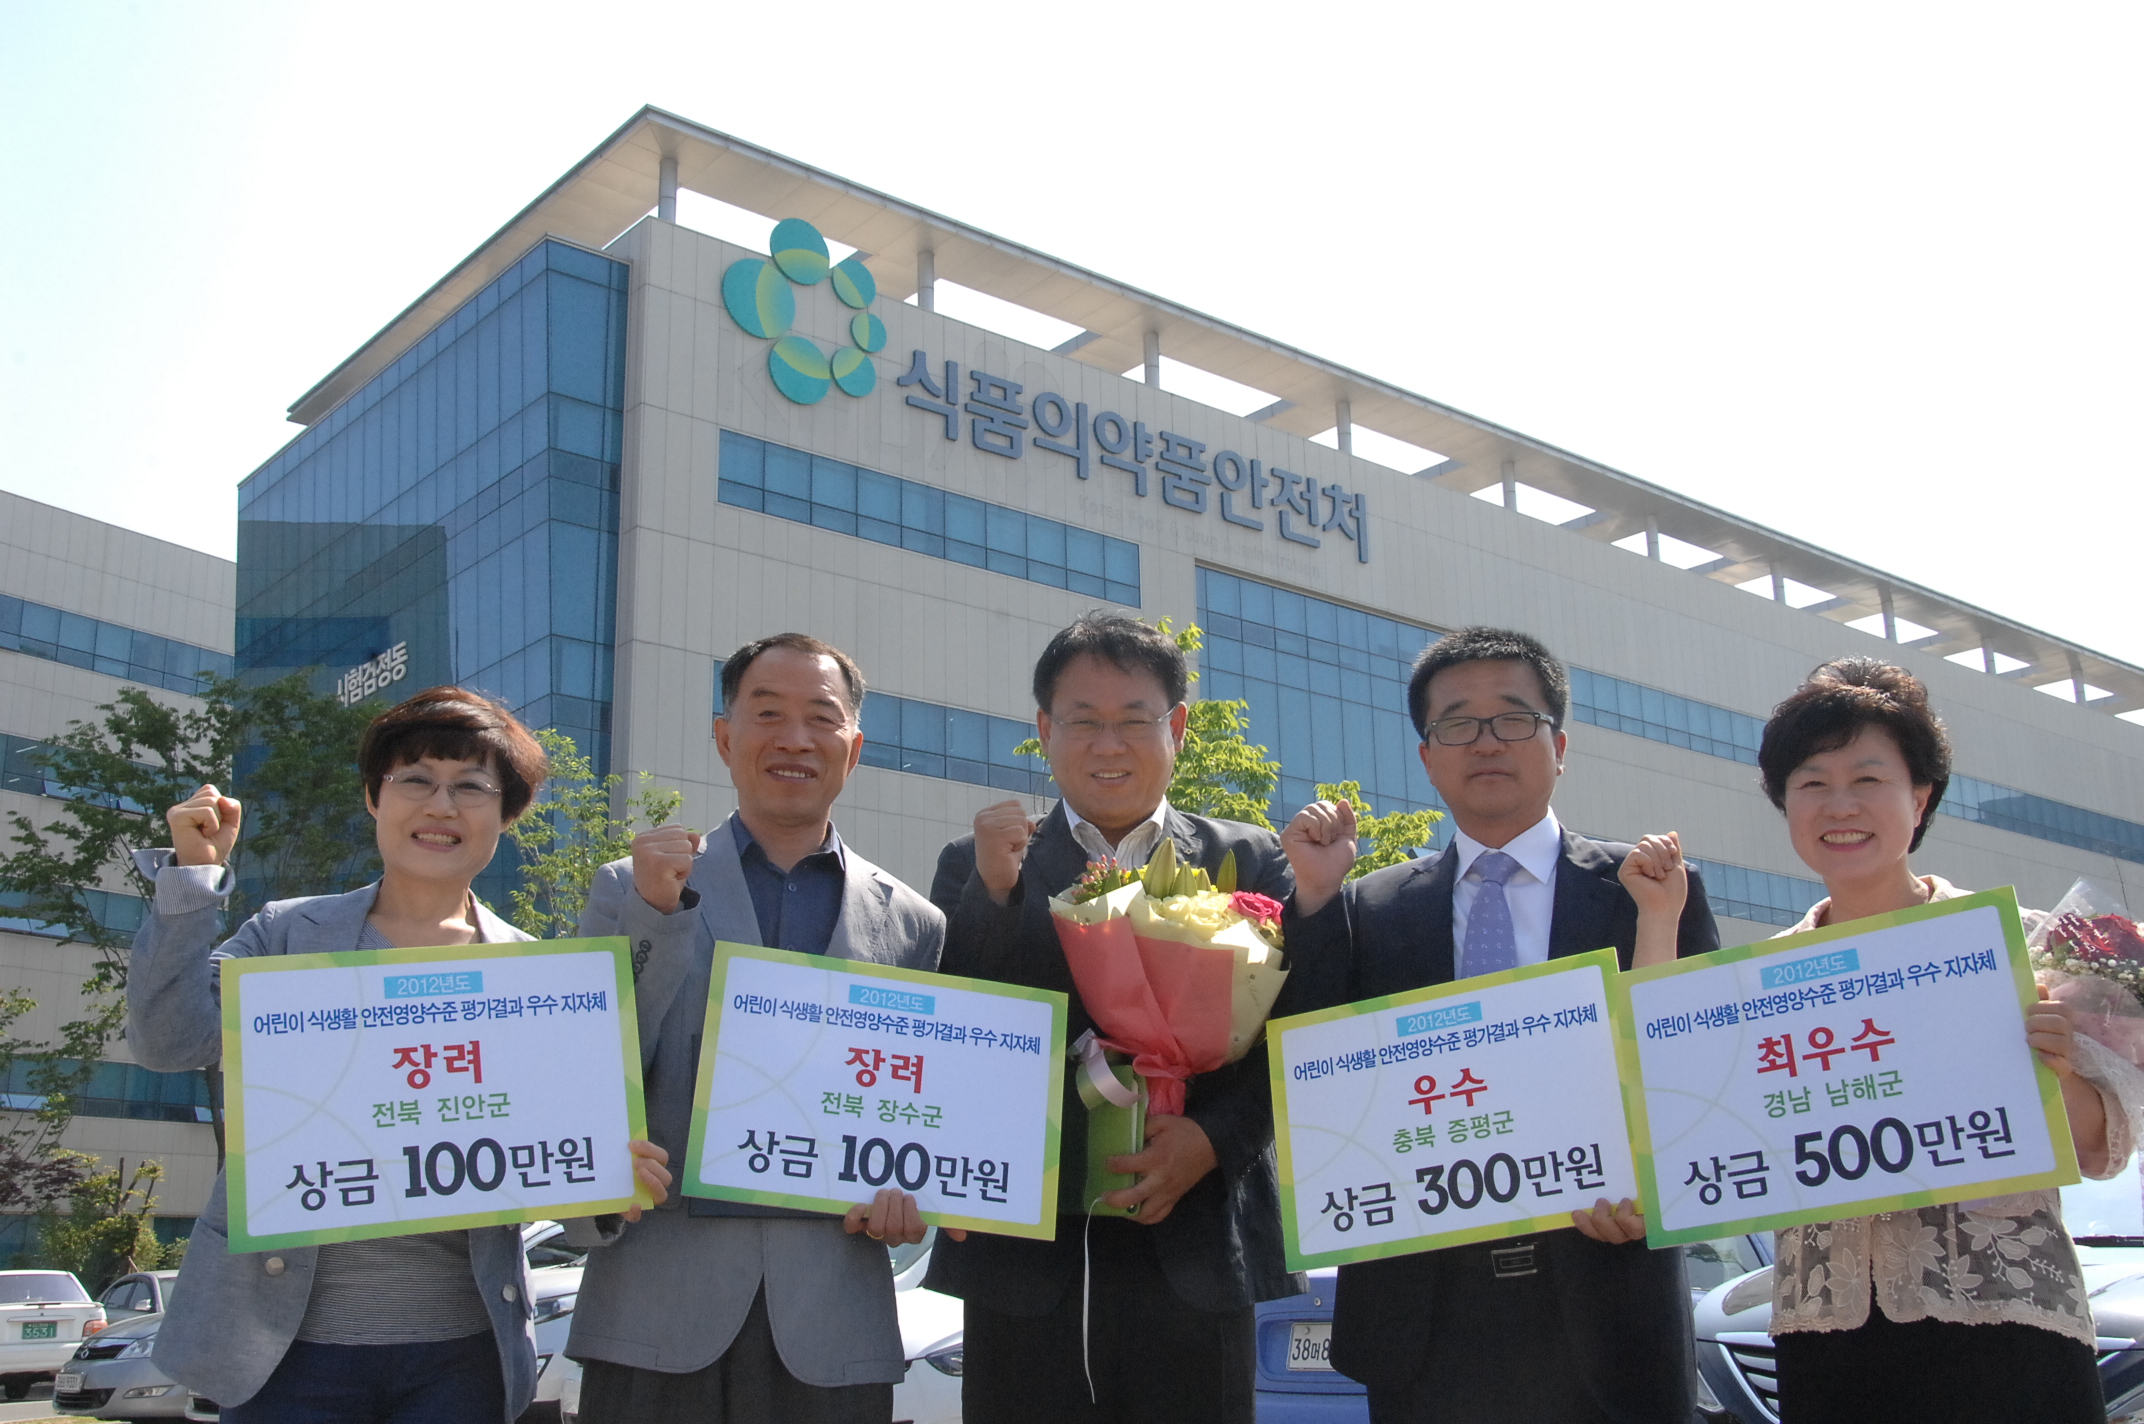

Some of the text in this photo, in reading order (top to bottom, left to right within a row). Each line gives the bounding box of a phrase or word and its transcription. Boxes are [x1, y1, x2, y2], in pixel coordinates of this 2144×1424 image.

[897, 350, 1369, 564] 식품의약품안전처
[338, 641, 408, 707] 시험검정동
[397, 975, 471, 995] 2012년도
[1773, 953, 1847, 984] 2012년도
[254, 991, 606, 1035] 어린이 식생활 안전영양수준 평가결과 우수 지자체
[859, 988, 924, 1011] 2012년도
[1646, 949, 1996, 1041] 어린이 식생활 안전영양수준 평가결과 우수 지자체
[734, 993, 1040, 1054] 어린이 식생활 안전영양수준 평가결과 우수 지자체
[1294, 1003, 1597, 1081] 어린이 식생활 안전영양수준 평가결과 우수 지자체
[1408, 1007, 1472, 1033] 2012년도
[392, 1041, 482, 1089] 장려
[845, 1047, 924, 1093] 장려
[1757, 1018, 1896, 1078] 최우수
[372, 1092, 511, 1128] 전북 진안군
[821, 1092, 943, 1129] 전북 장수군
[1408, 1068, 1488, 1115] 우수
[1763, 1070, 1904, 1118] 경남 남해군
[1393, 1110, 1514, 1153] 충북 증평군
[286, 1137, 595, 1211] 상금 100만원
[738, 1129, 1009, 1203] 상금 100만원
[1684, 1107, 2015, 1206] 상금 500만원
[1321, 1143, 1605, 1232] 상금 300만원
[25, 1327, 53, 1338] 3531
